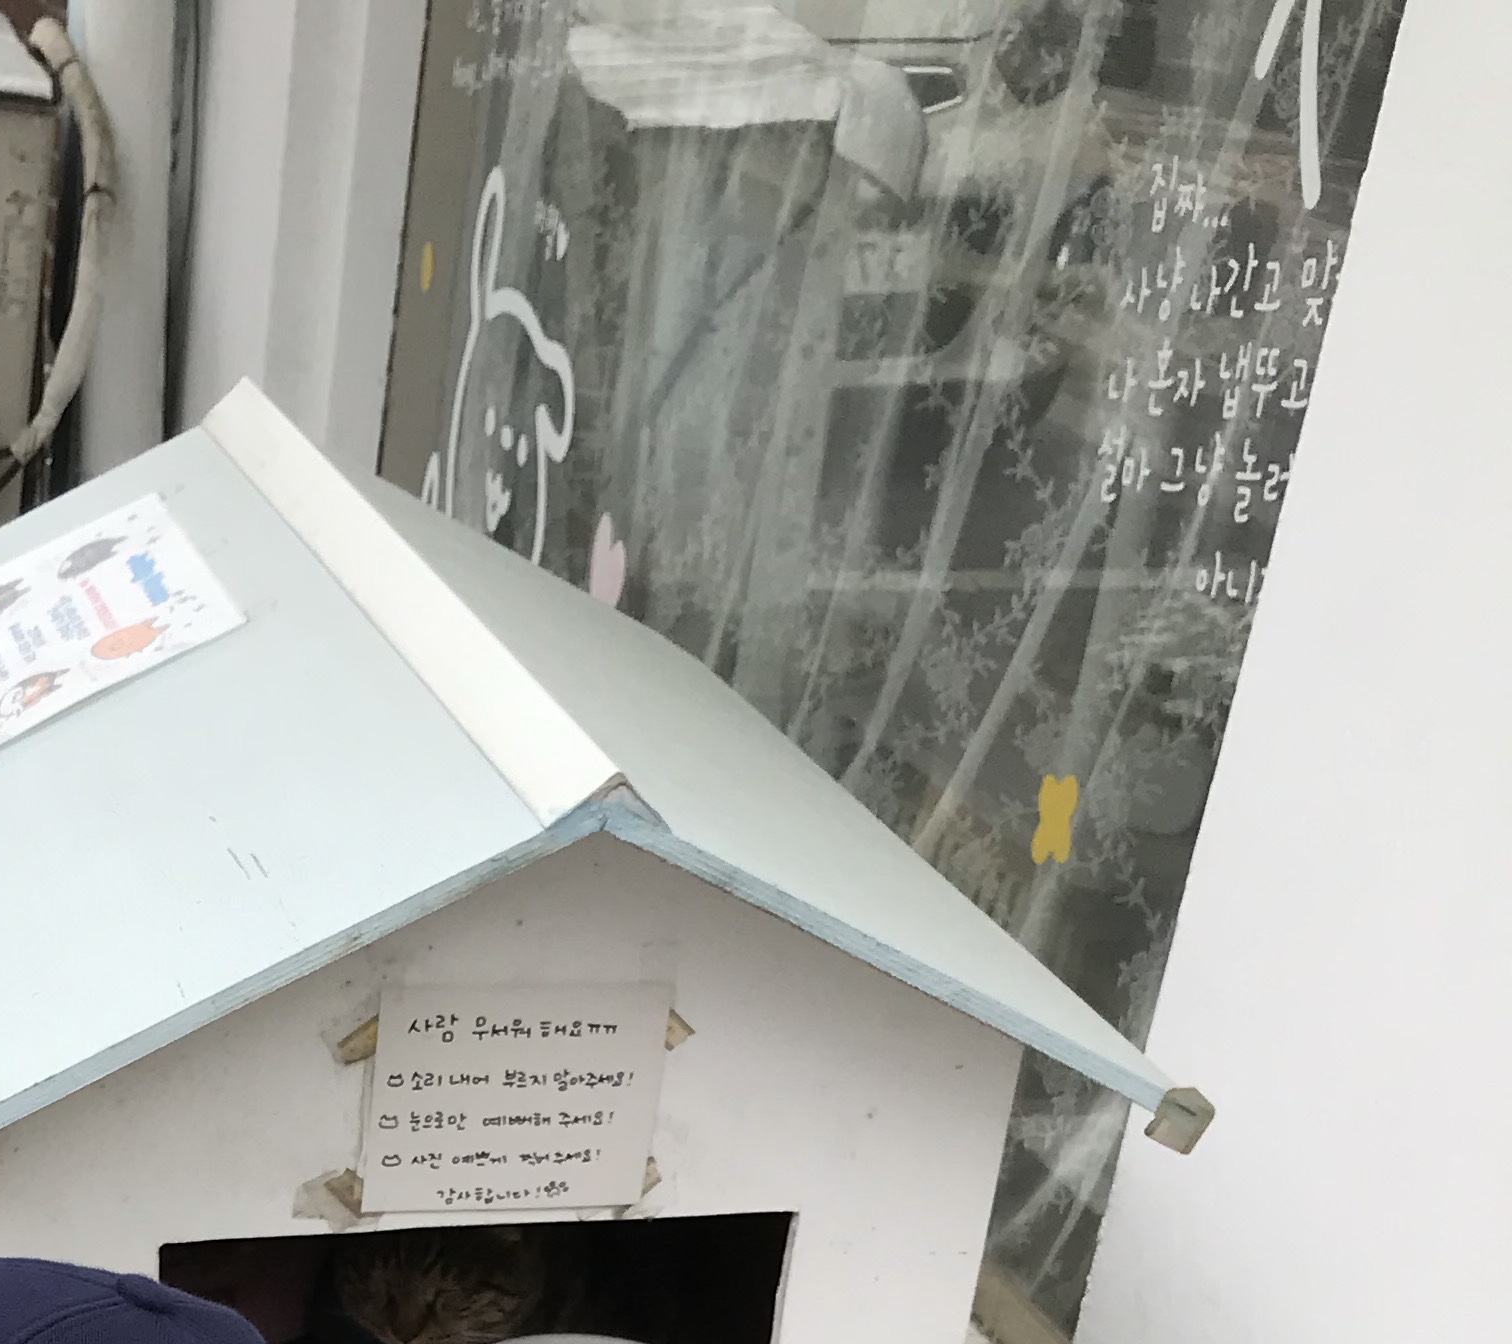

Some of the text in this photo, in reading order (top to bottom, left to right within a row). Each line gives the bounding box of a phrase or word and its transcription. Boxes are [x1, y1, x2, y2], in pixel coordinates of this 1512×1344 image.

[1120, 246, 1186, 322] 사냥
[1301, 240, 1340, 327] 맞
[1108, 357, 1138, 403] 나
[1148, 336, 1205, 416] 혼자
[1098, 425, 1151, 502] 설마
[1160, 431, 1225, 506] 그냥
[1196, 551, 1268, 603] 아니
[408, 1014, 459, 1043] 사람
[502, 1069, 547, 1088] 부르지
[409, 1111, 467, 1132] 눈으로만
[411, 1152, 442, 1169] 사진
